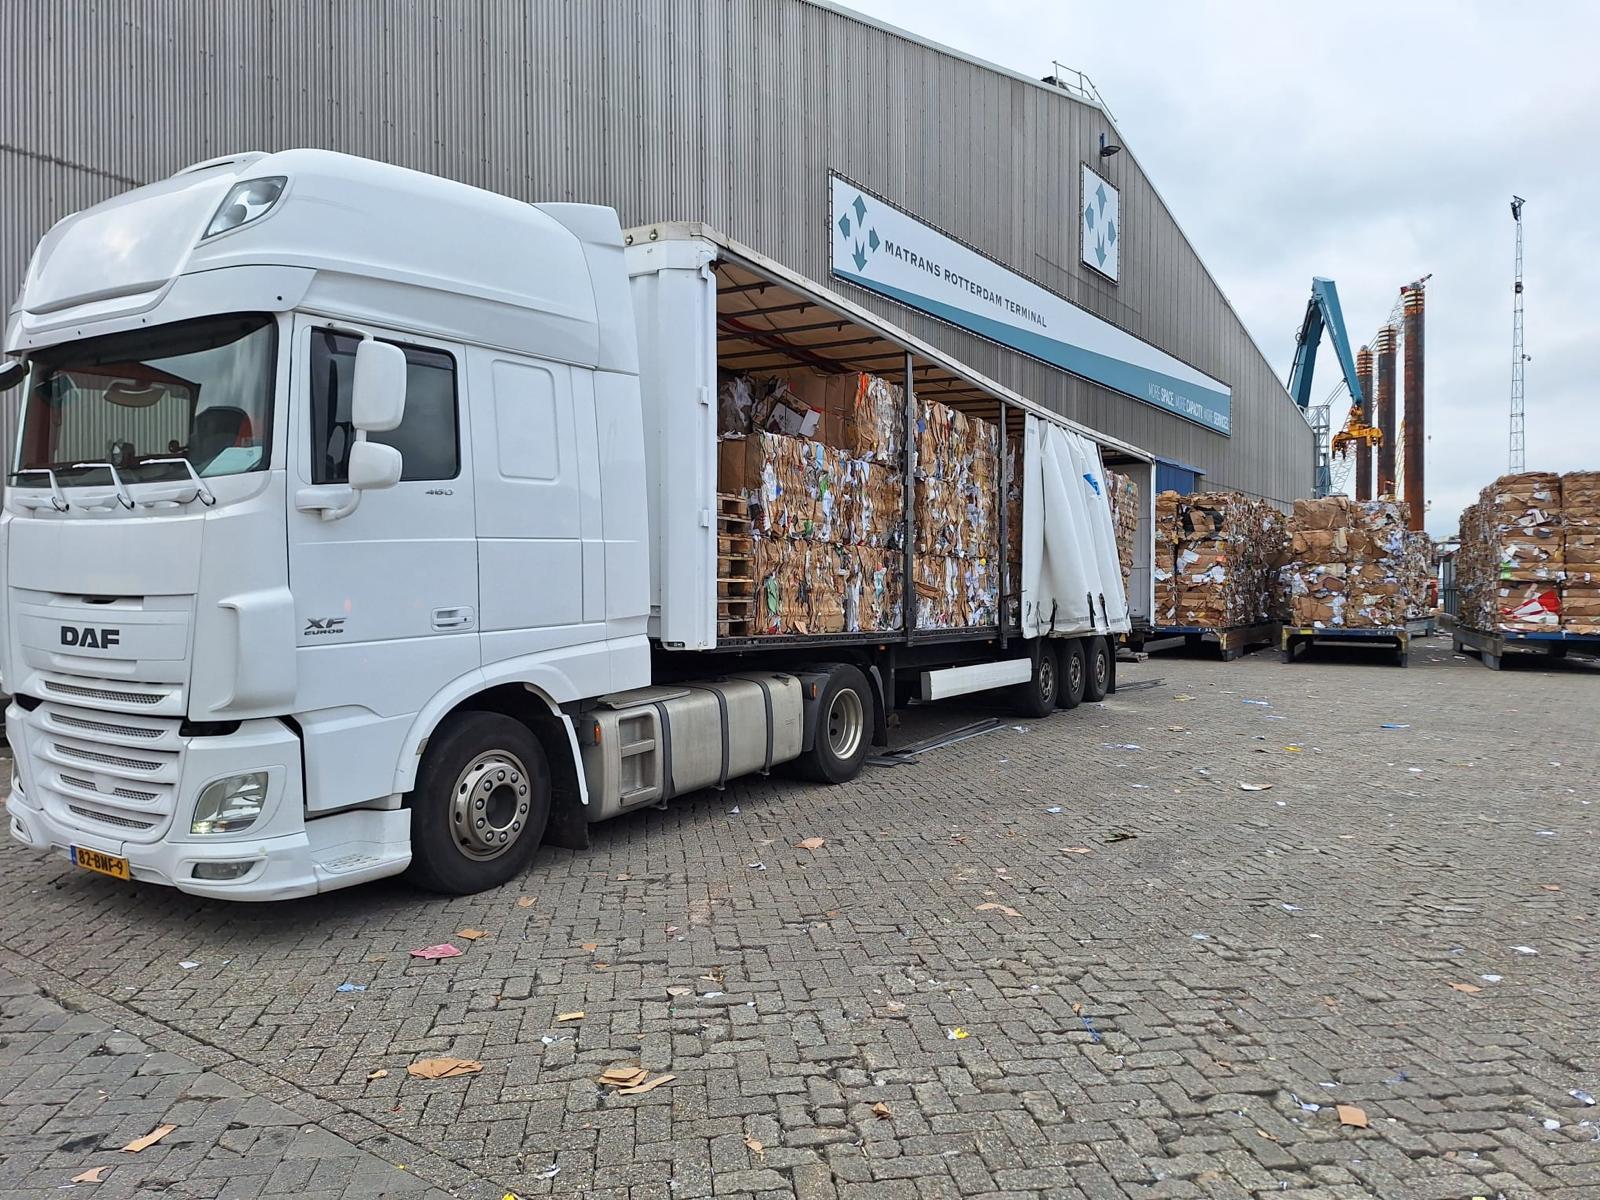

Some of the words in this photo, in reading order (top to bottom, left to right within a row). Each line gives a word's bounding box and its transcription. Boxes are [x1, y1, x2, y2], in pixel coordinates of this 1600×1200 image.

[885, 240, 941, 277] MATRANS
[944, 269, 1002, 307] ROTTERDAM
[1005, 298, 1047, 328] TERMINAL
[1148, 383, 1160, 401] MORE
[304, 617, 347, 630] XF
[61, 626, 119, 649] DAF
